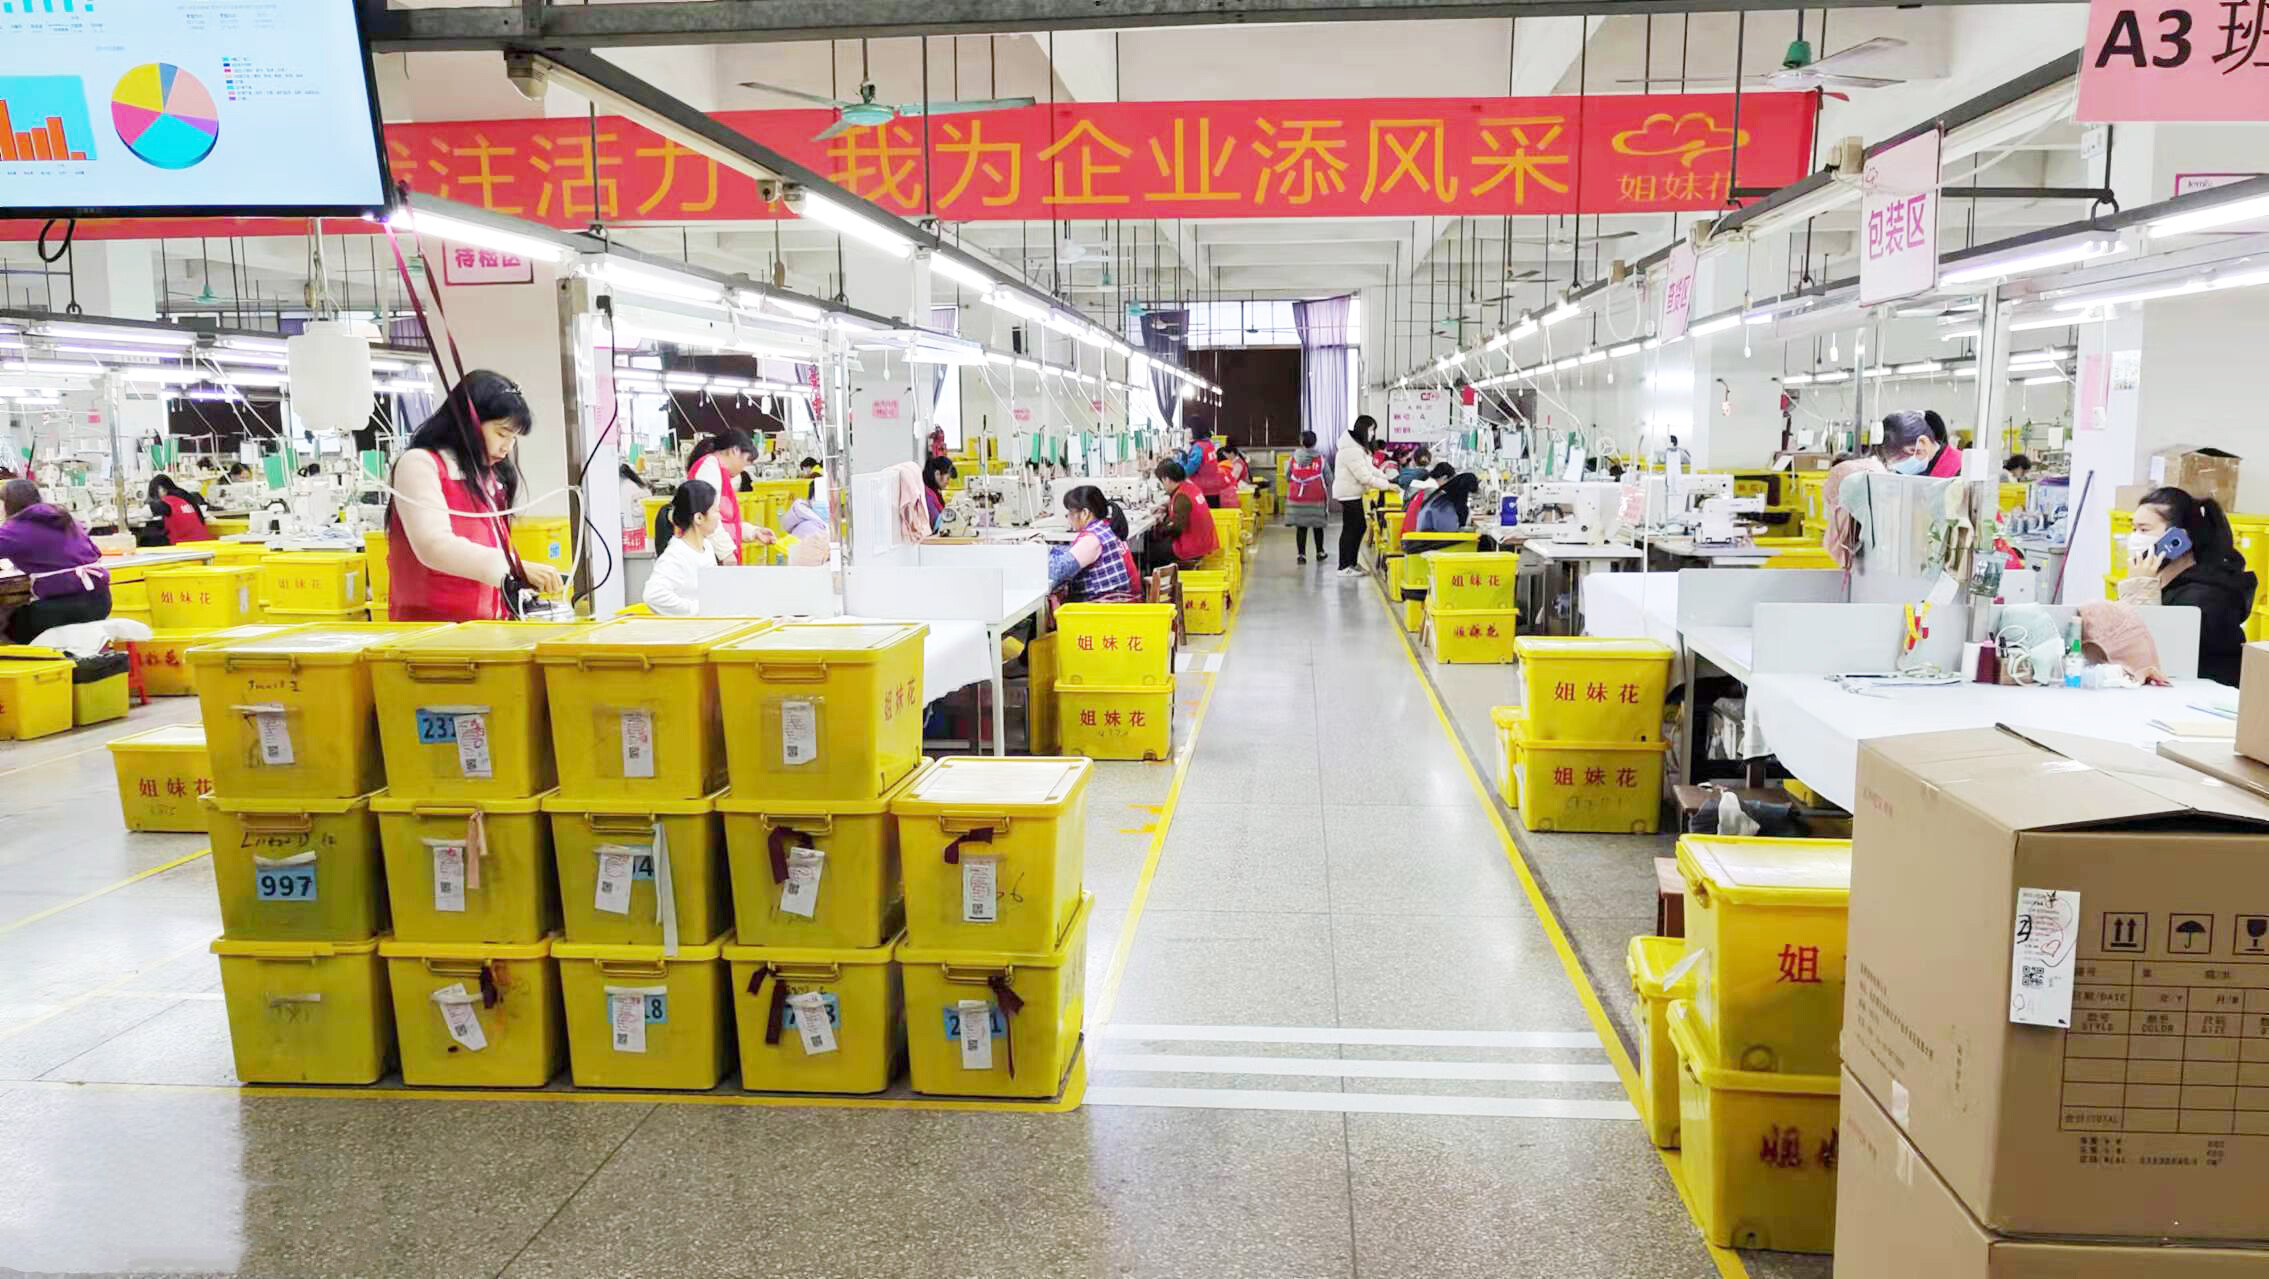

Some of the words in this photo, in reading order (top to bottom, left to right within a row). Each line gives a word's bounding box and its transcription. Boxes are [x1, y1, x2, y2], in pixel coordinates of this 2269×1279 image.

[2095, 9, 2193, 68] A3
[1868, 193, 1926, 261] 包装区
[1452, 573, 1499, 587] 姐妹花
[160, 591, 211, 605] 姐妹花
[1078, 634, 1143, 652] 姐妹花
[1554, 680, 1640, 704] 姐妹花
[1080, 708, 1146, 727] 姐妹花
[1553, 766, 1638, 788] 姐妹花
[261, 875, 312, 896] 997
[2142, 1023, 2174, 1032] COLOR
